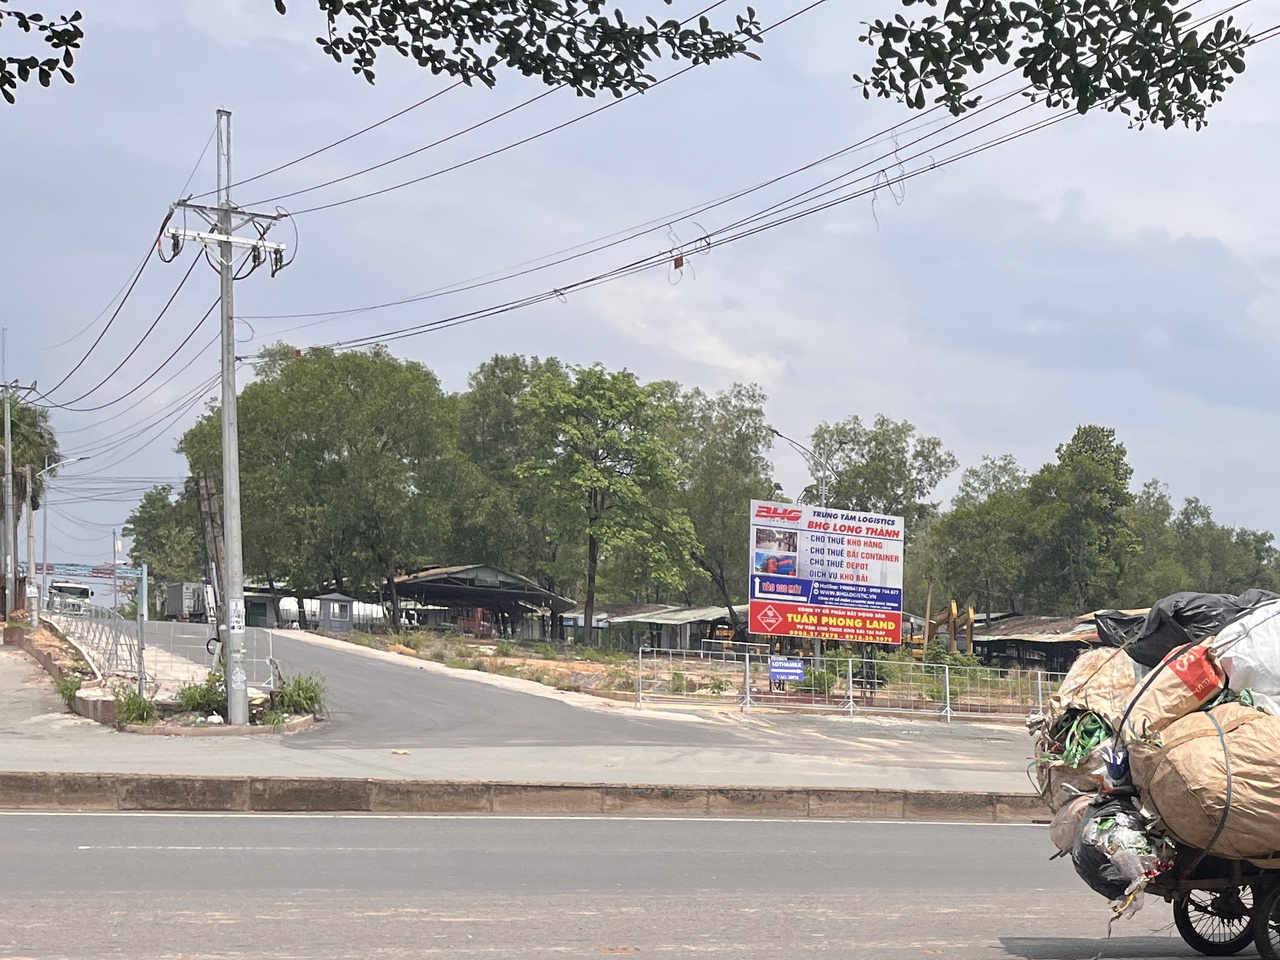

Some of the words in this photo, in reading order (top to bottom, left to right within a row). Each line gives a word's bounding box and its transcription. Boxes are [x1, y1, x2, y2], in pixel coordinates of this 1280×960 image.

[813, 511, 838, 519] TRUNG
[841, 513, 856, 521] TÂM
[858, 516, 895, 525] LOGISTICS
[807, 521, 830, 530] BHG
[833, 524, 862, 534] LONG
[866, 526, 900, 538] THÀNH
[811, 534, 825, 543] CHO
[828, 536, 845, 545] THUÊ
[863, 540, 883, 549] HÀNG
[810, 547, 824, 555] CHO
[827, 548, 844, 557] THUÊ
[861, 552, 899, 562] CONTAINER
[810, 558, 824, 566] CHO
[827, 559, 844, 568] THUÊ
[846, 562, 869, 570] DEPOT
[840, 573, 854, 581] KHO
[762, 582, 775, 591] VÀO
[787, 613, 818, 624] TUẤN
[821, 616, 863, 627] PHONG
[866, 620, 895, 630] LAND
